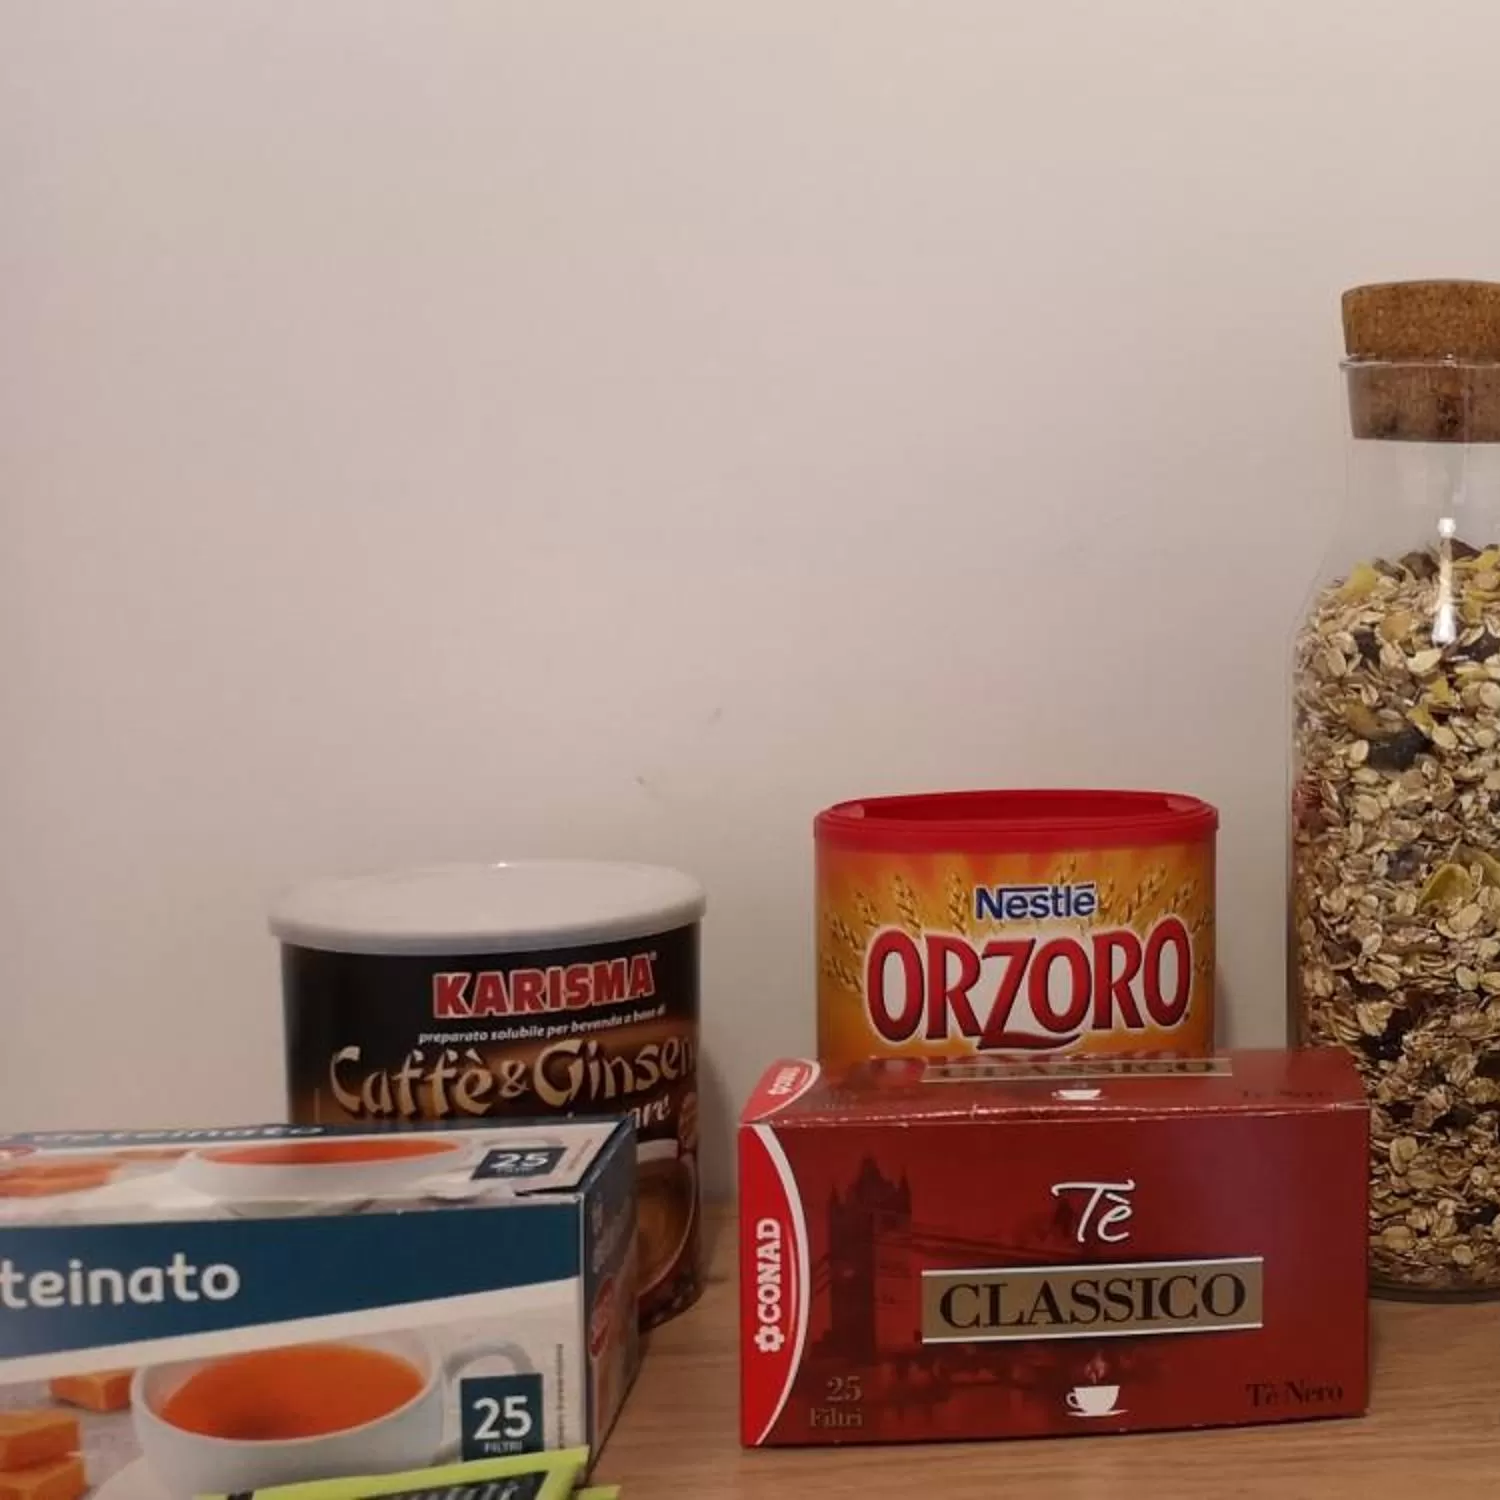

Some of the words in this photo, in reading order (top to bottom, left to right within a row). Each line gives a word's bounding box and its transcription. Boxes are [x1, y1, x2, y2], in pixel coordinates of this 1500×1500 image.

[432, 956, 656, 1019] KARISMA
[865, 916, 1192, 1051] ORZORO
[419, 1030, 488, 1045] preparato
[490, 1024, 545, 1041] solubile
[546, 1022, 570, 1038] per
[571, 1014, 622, 1032] bevanda
[329, 1045, 494, 1116] Caffè
[490, 1151, 549, 1169] 25
[1051, 1178, 1136, 1243] Tè
[0, 1254, 241, 1309] teinato
[757, 1217, 782, 1322] CONAD
[938, 1272, 1248, 1330] CLASSICO
[825, 1375, 863, 1402] 25
[472, 1395, 533, 1441] 25
[808, 1405, 863, 1429] Filtri
